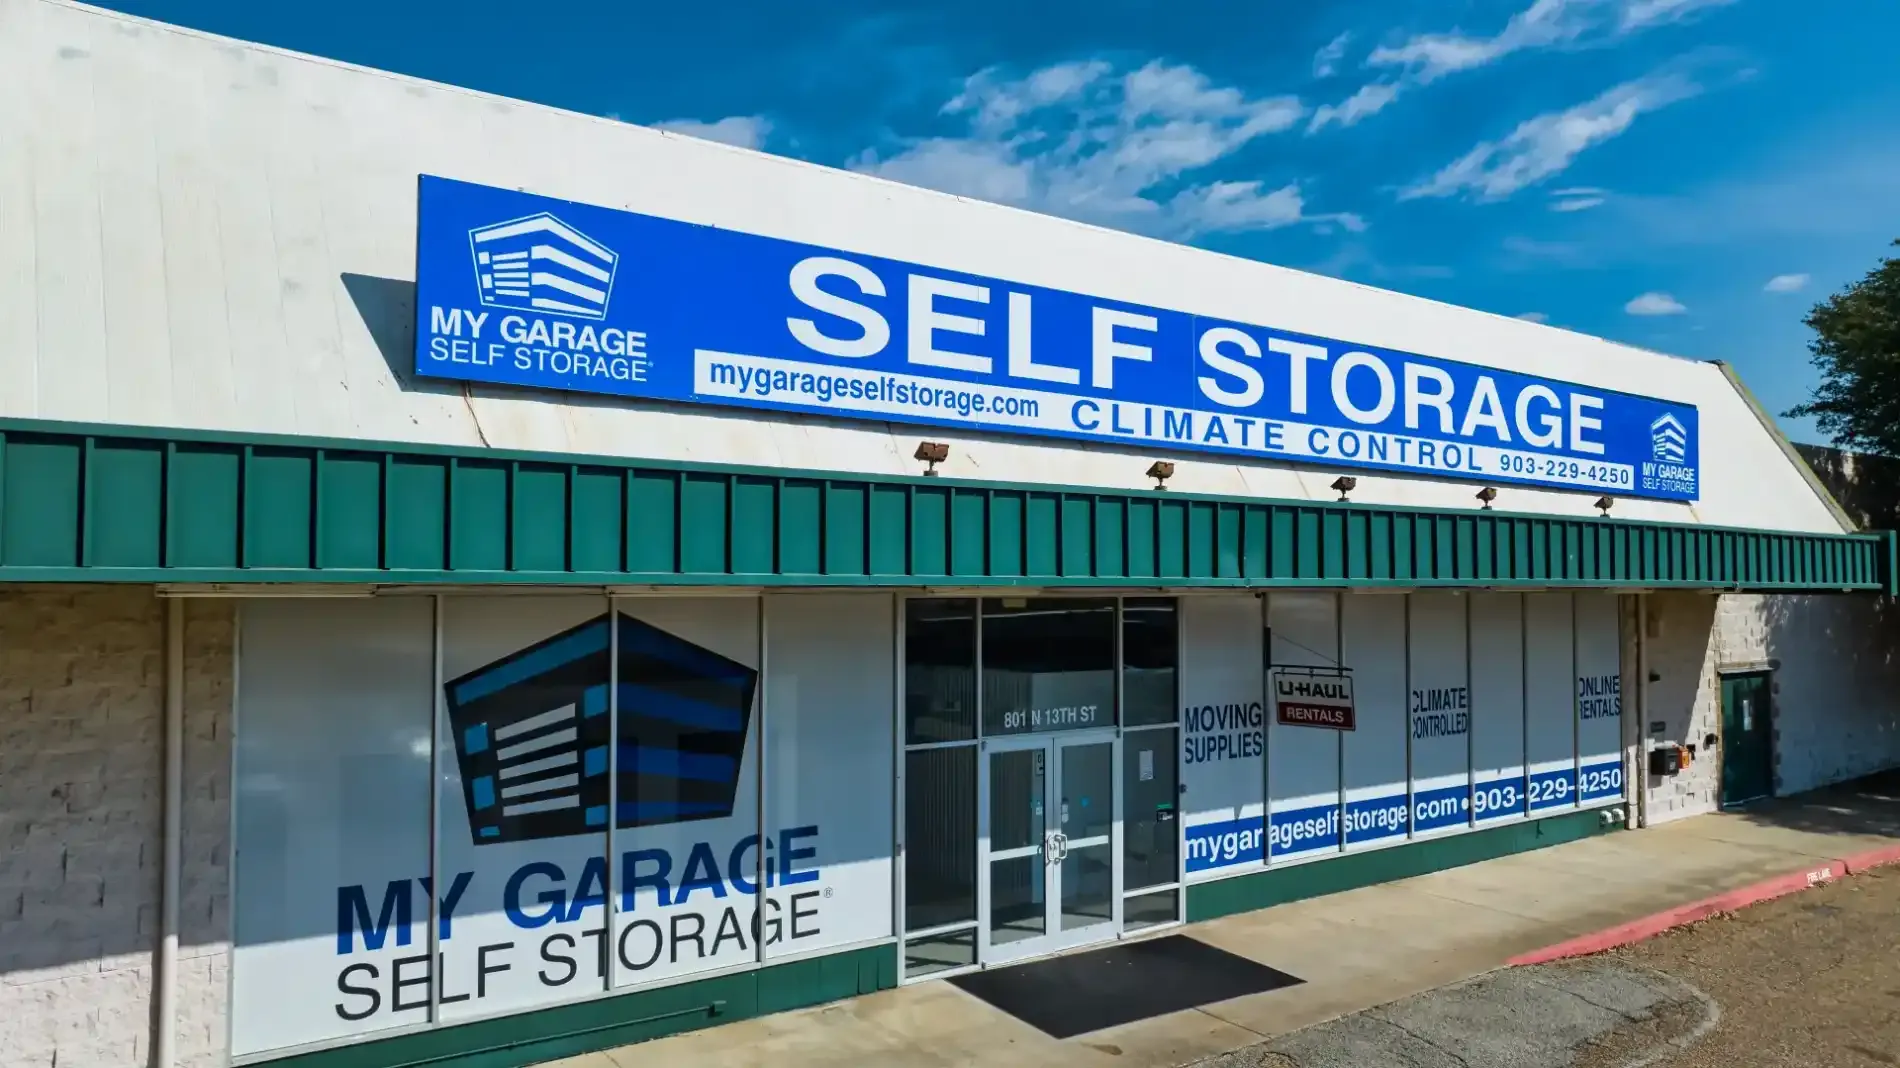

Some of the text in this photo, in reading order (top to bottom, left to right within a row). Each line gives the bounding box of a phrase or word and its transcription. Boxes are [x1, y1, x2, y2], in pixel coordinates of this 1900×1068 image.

[431, 306, 647, 358] MY GARAGE
[430, 337, 648, 382] SELF STORAGE
[787, 256, 1604, 455] SELF STORAGE
[710, 361, 1039, 418] mygarageselfstorage.com
[1071, 400, 1482, 471] CLIMATE CONTROL
[1500, 454, 1629, 484] 903-229-4250
[1642, 461, 1695, 481] MY GARAGE
[1642, 477, 1695, 493] SELF STORAGE
[1278, 681, 1349, 699] U-HAUL
[1004, 705, 1097, 728] 801 N 13TH ST
[1185, 702, 1262, 732] MOVING
[1286, 706, 1344, 723] RENTALS
[1185, 731, 1263, 764] SUPPLIES
[1474, 768, 1621, 813] 903-229-4250
[337, 825, 820, 955] MY GARAGE
[335, 942, 515, 1021] SELF
